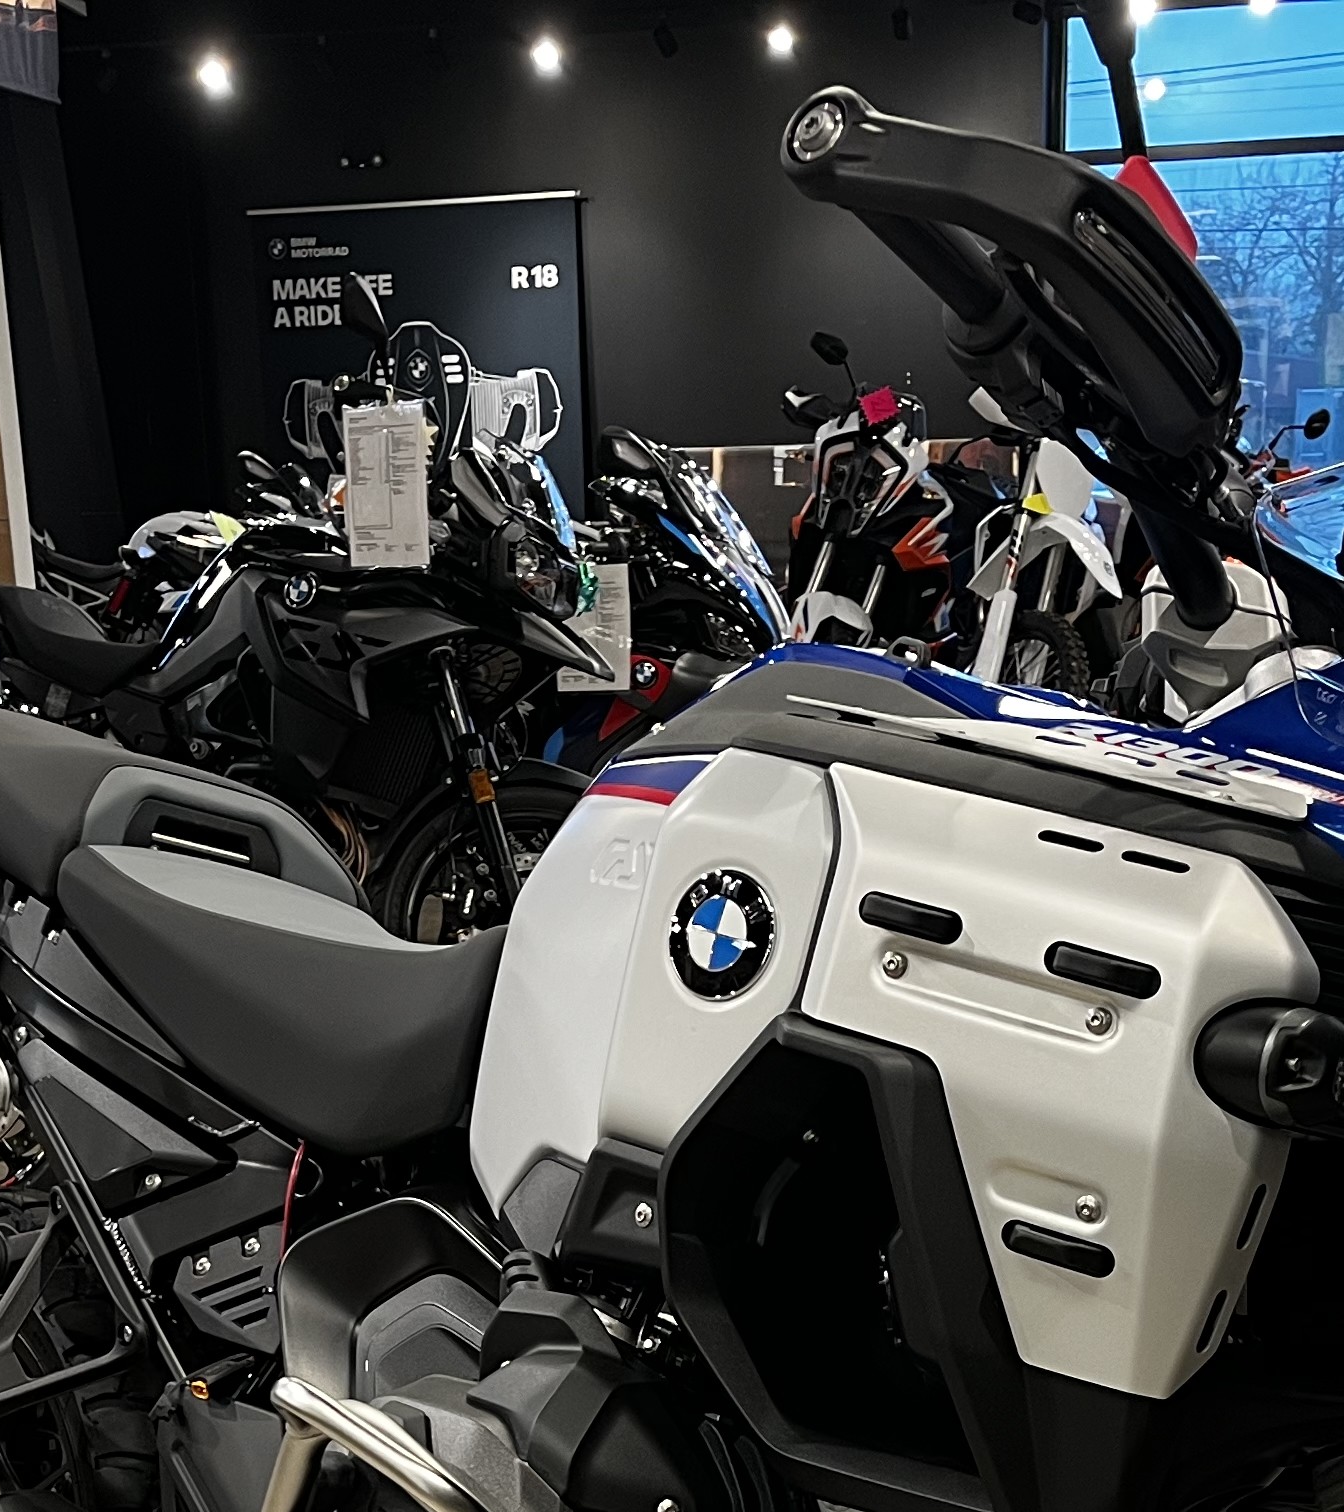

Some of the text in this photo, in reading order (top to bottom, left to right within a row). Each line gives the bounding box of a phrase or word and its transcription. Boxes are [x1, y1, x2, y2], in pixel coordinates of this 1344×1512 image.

[290, 237, 316, 247] BMW
[290, 246, 349, 258] MOTORRAD
[272, 277, 342, 301] MAKE
[274, 307, 292, 328] A
